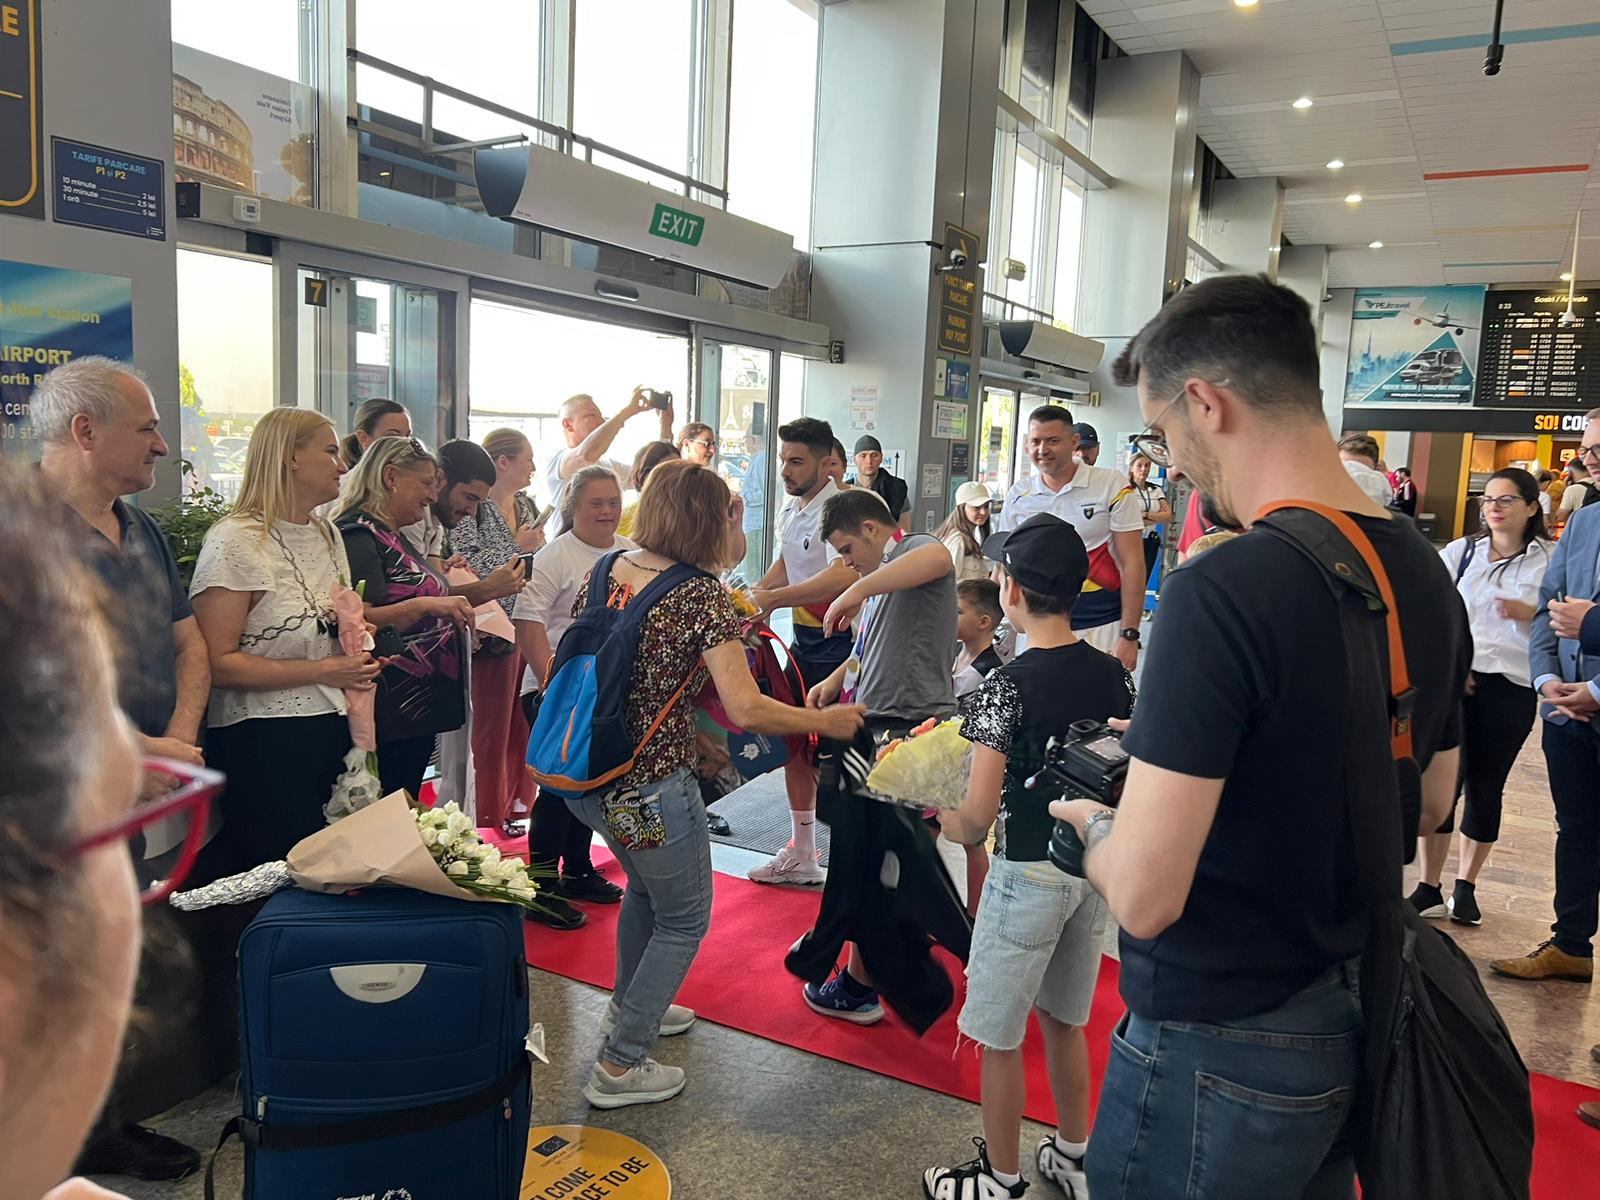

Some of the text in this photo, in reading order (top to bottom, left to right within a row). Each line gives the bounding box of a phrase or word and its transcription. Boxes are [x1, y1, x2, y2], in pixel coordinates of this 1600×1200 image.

[2, 5, 19, 36] E
[72, 150, 147, 175] TARIFE PARCARE
[96, 166, 106, 176] P1
[115, 170, 127, 180] P2
[71, 178, 97, 190] minute
[72, 187, 99, 198] minute
[658, 211, 699, 240] EXIT
[310, 282, 323, 304] 7
[0, 345, 72, 365] IRPORT
[1, 373, 30, 386] orth
[1534, 414, 1560, 430] SO!
[599, 1170, 630, 1187] TO
[620, 1156, 651, 1175] BE
